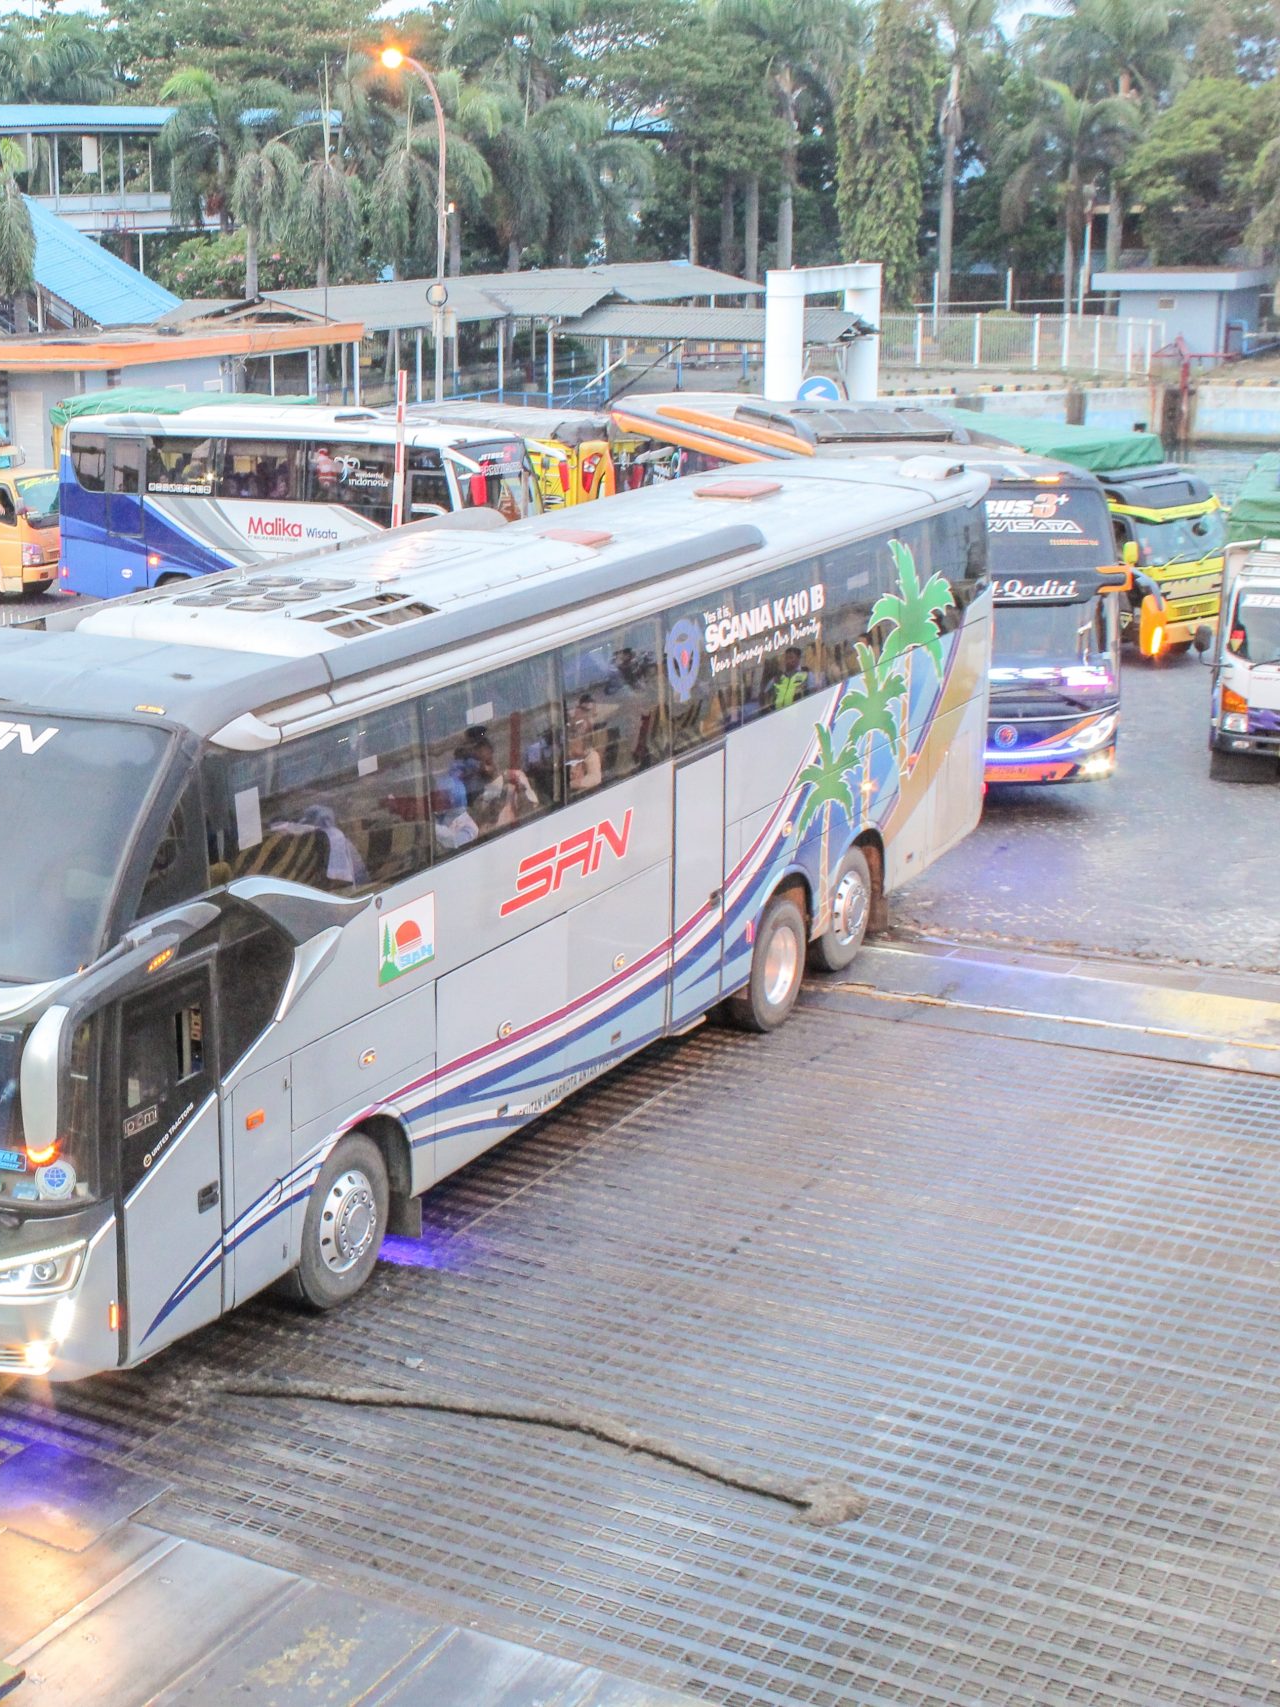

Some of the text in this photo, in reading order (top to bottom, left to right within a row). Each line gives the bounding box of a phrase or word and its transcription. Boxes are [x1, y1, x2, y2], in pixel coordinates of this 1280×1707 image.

[247, 516, 338, 539] Malika Wisata
[703, 611, 717, 625] Yes
[705, 583, 825, 654] SCANIA K410 B
[710, 616, 821, 678] Your Journey is Our Priority
[499, 806, 634, 918] SAN
[151, 1101, 195, 1157] UNITED TRACTORS
